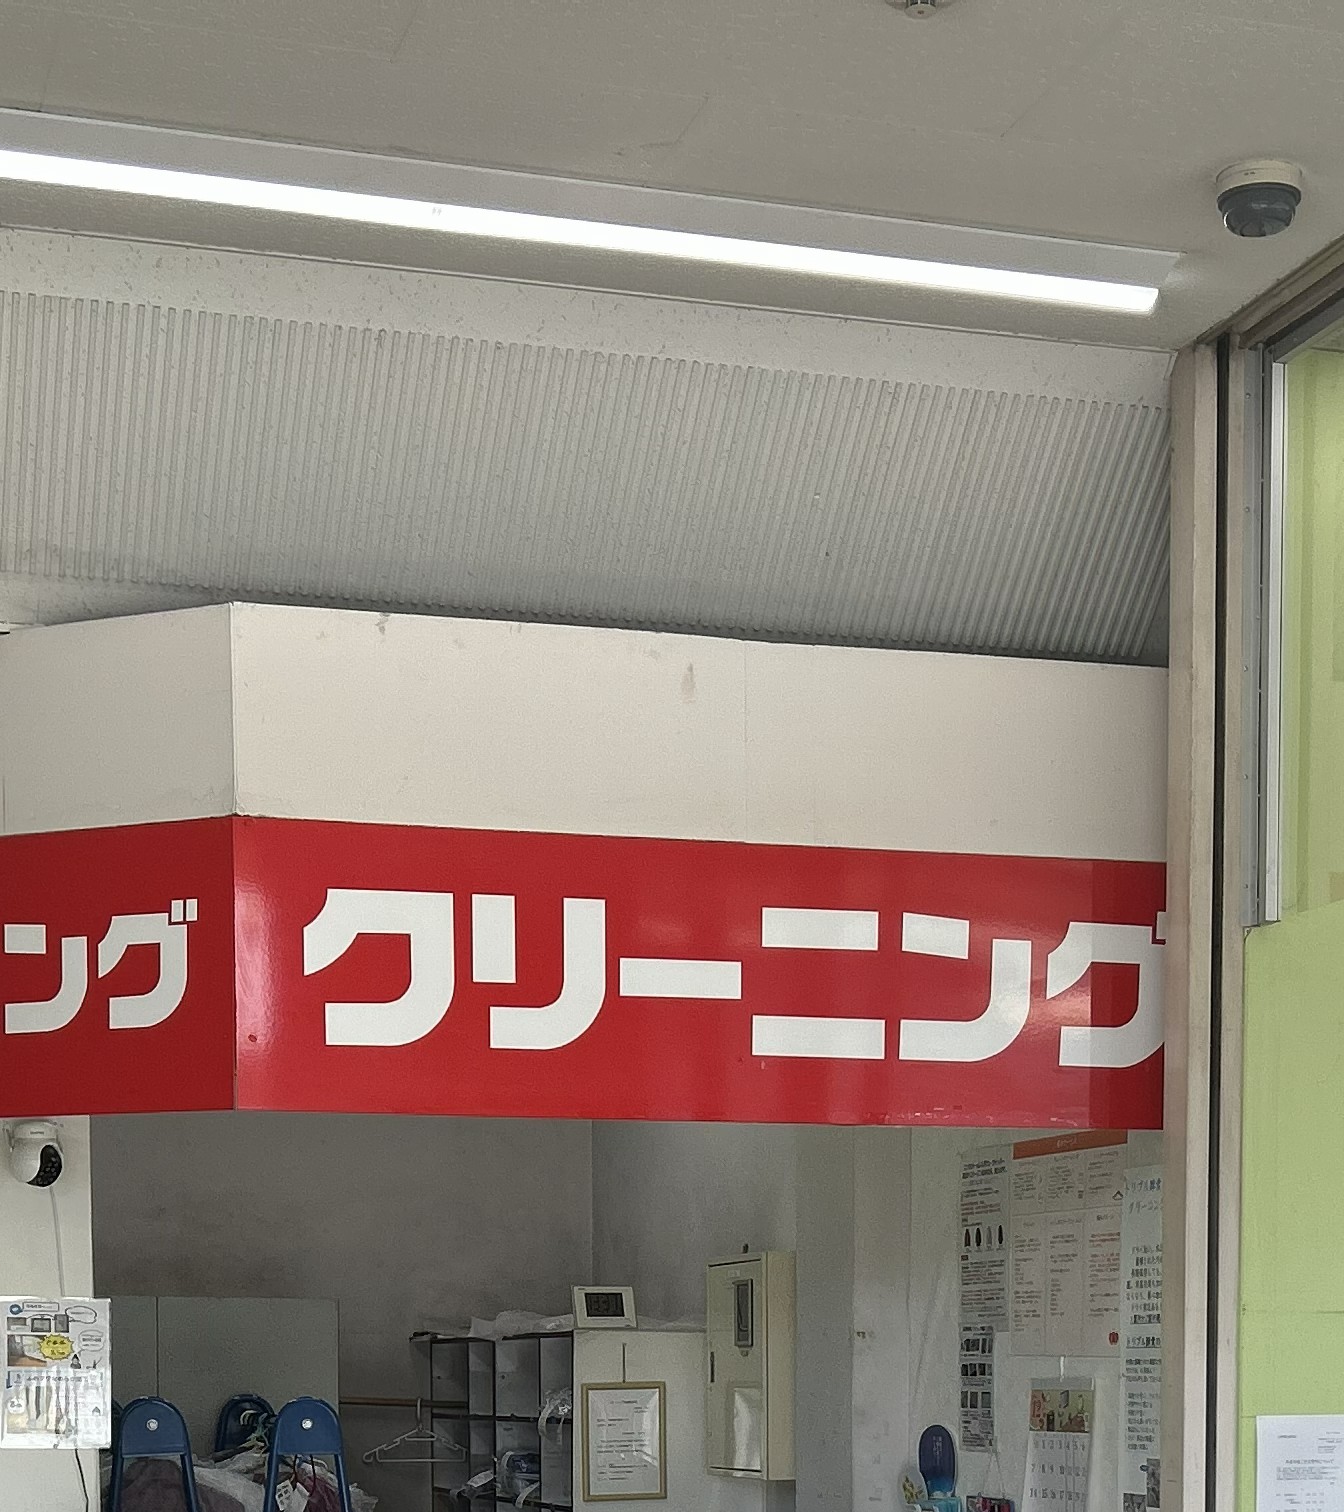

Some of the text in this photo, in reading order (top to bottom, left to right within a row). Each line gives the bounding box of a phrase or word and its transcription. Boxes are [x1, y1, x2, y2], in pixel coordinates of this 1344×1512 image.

[304, 889, 1166, 1068] クリーニング
